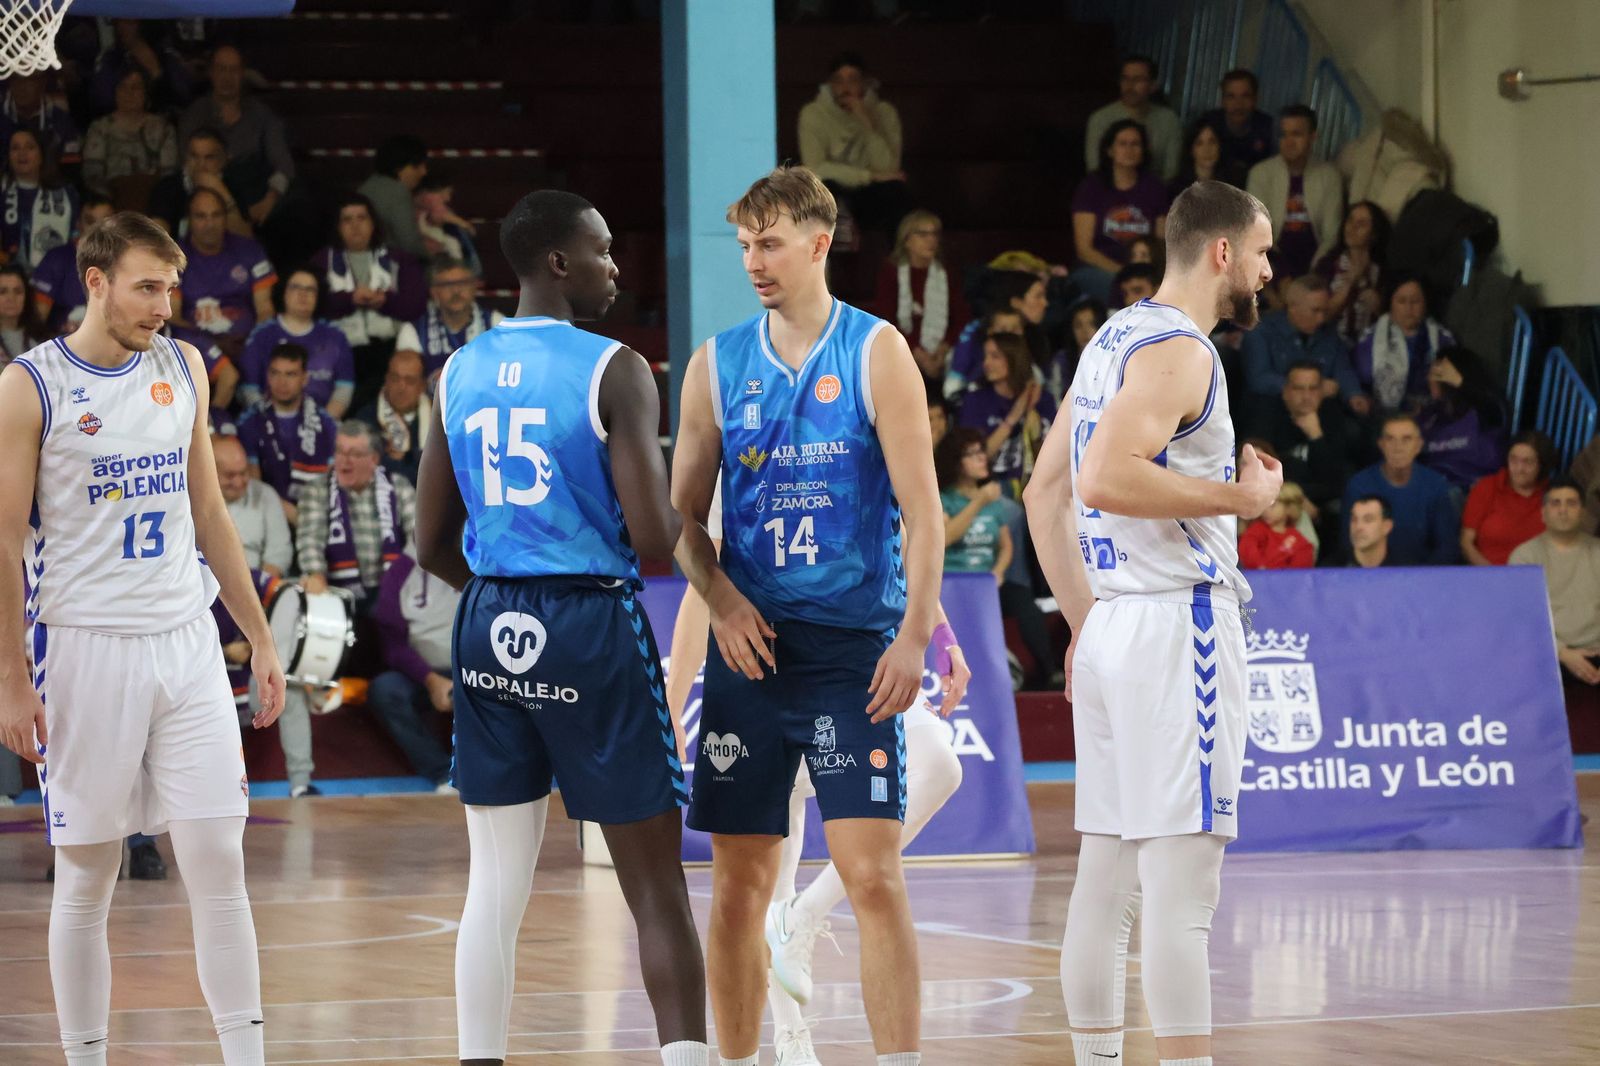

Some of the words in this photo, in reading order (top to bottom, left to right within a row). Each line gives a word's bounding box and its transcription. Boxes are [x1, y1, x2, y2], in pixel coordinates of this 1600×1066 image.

[497, 361, 522, 387] LO
[91, 453, 123, 464] súper
[92, 447, 183, 478] agropal
[464, 407, 553, 506] 15
[778, 458, 793, 467] DE
[795, 455, 834, 466] ZAMORA
[801, 441, 850, 457] RURAL
[771, 495, 833, 511] ZAMORA
[122, 511, 167, 559] 13
[763, 515, 819, 567] 14
[461, 667, 579, 703] MORALEJO
[1333, 717, 1447, 749] Junta
[1458, 714, 1508, 746] de
[702, 741, 750, 758] ZAMORA
[1239, 757, 1371, 791] Castilla
[1380, 762, 1404, 797] y
[1416, 754, 1515, 787] León
